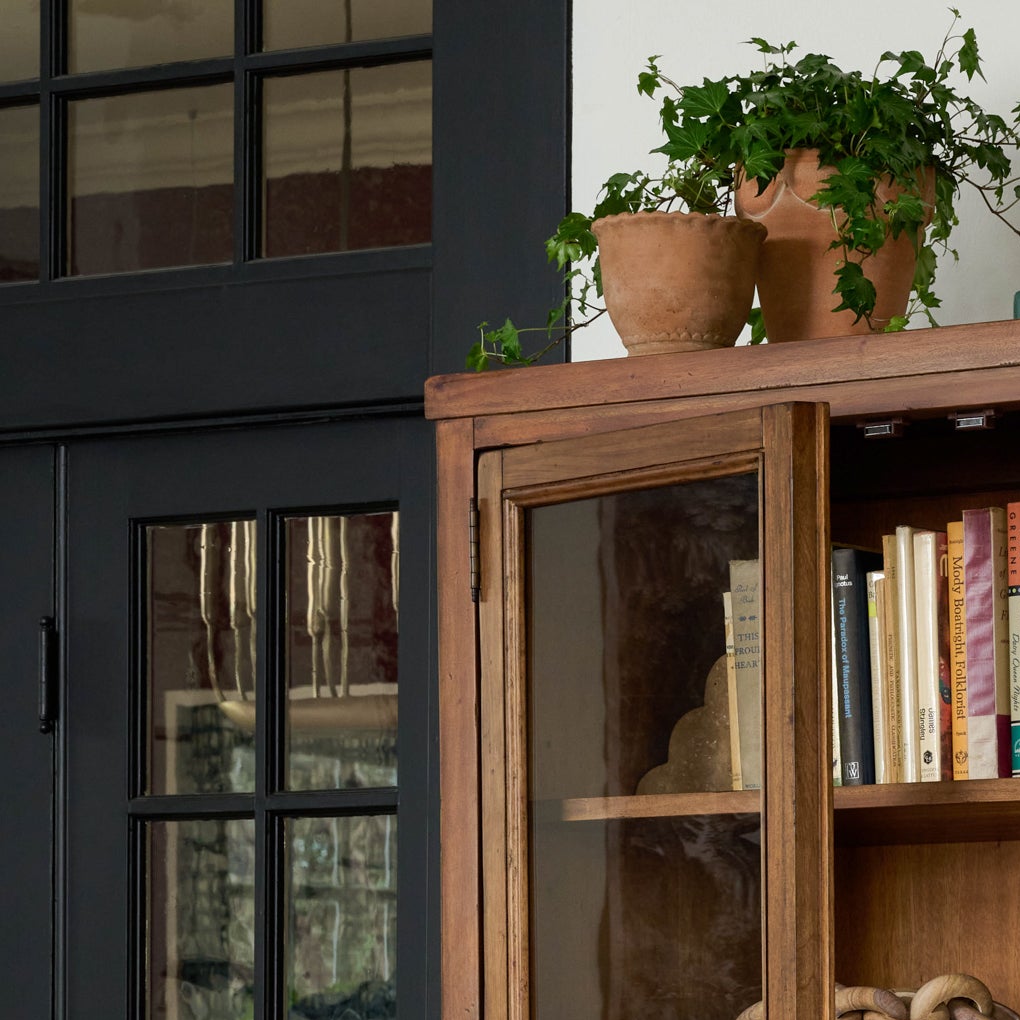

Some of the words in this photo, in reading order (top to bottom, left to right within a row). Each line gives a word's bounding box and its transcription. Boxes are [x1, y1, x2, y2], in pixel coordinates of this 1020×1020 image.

[1009, 512, 1017, 575] GREENE
[951, 556, 963, 594] Mody
[840, 616, 848, 654] Paradox
[953, 598, 965, 658] Boatright,
[1011, 633, 1020, 655] Dairy
[1011, 657, 1020, 683] Queen
[842, 665, 852, 719] Maupassant
[955, 661, 967, 719] Folklorist
[1011, 684, 1020, 712] Nights
